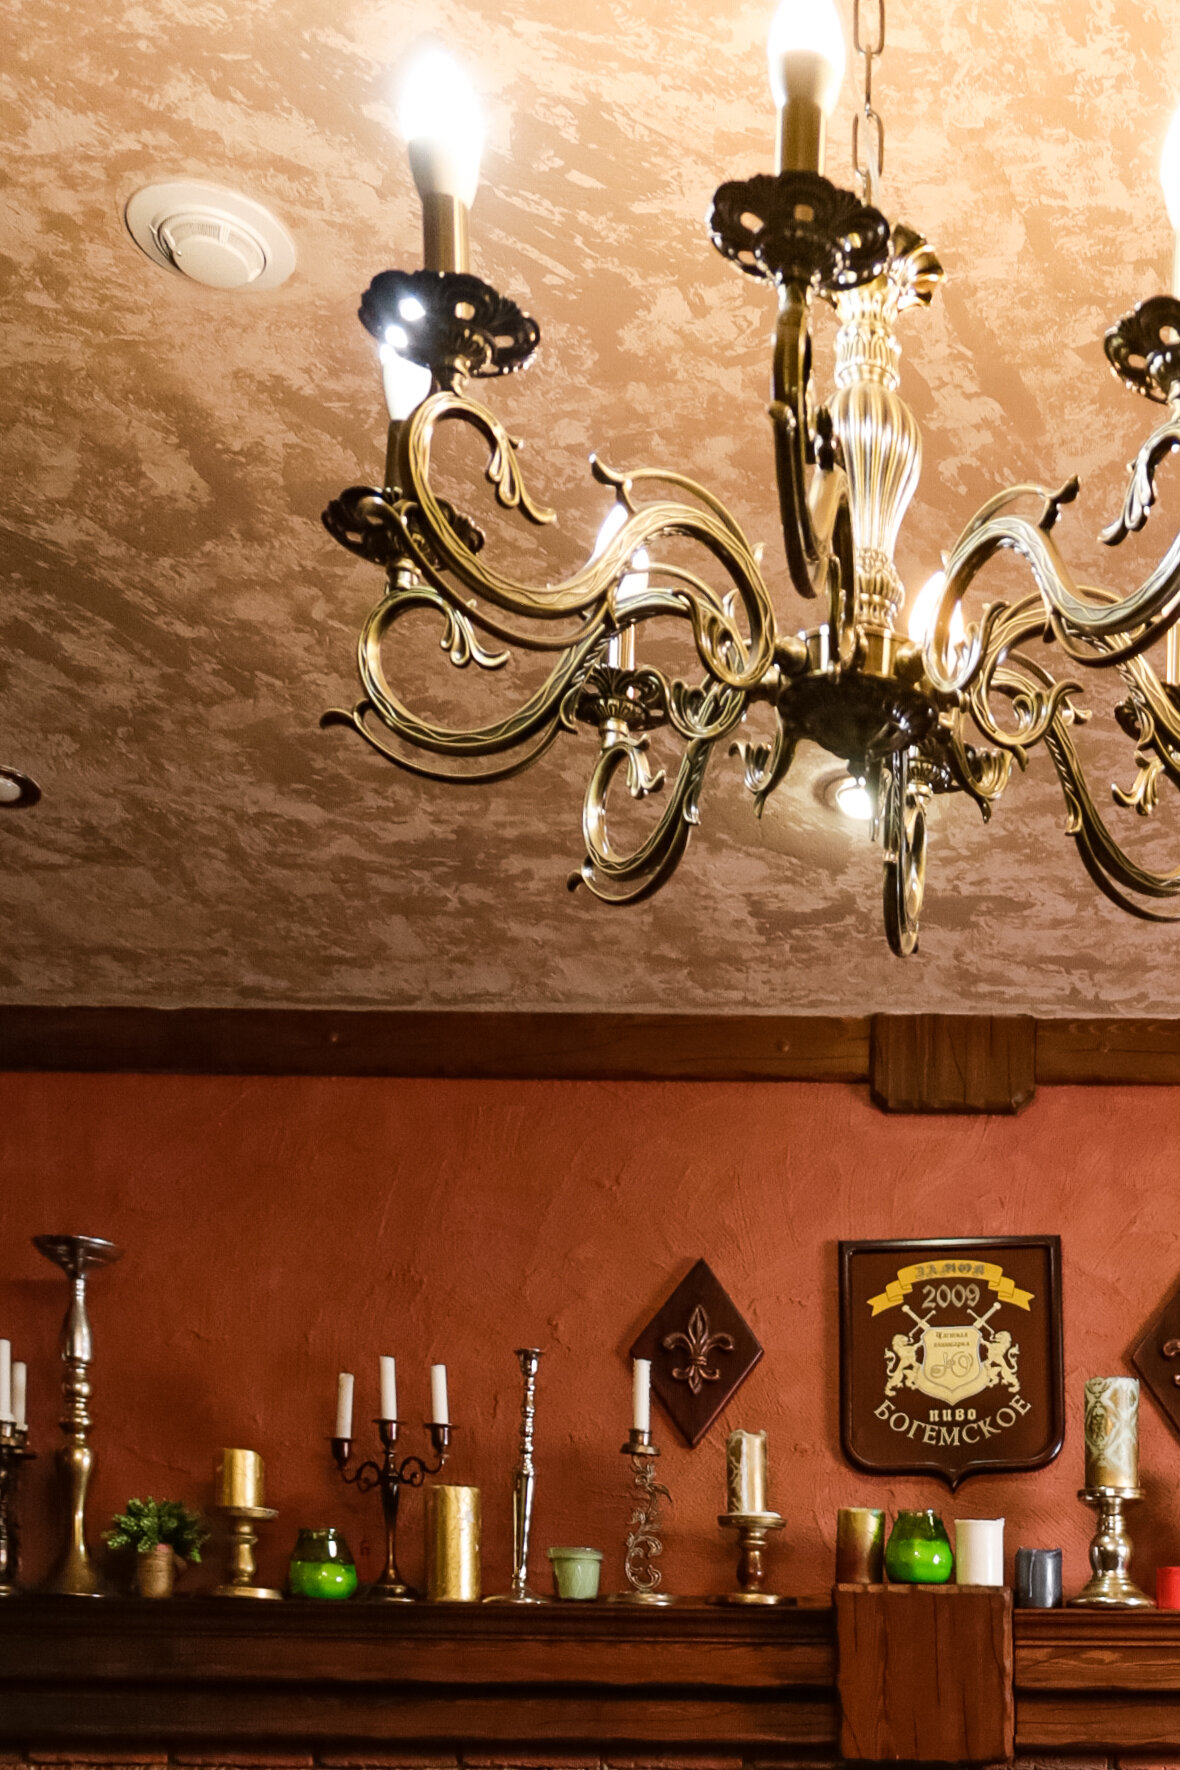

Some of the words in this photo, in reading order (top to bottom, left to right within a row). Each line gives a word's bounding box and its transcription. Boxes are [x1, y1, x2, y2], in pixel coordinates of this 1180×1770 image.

[921, 1282, 980, 1309] 2009
[873, 1394, 1032, 1446] БОГЕМСКОЕ
[929, 1408, 977, 1422] пиво
